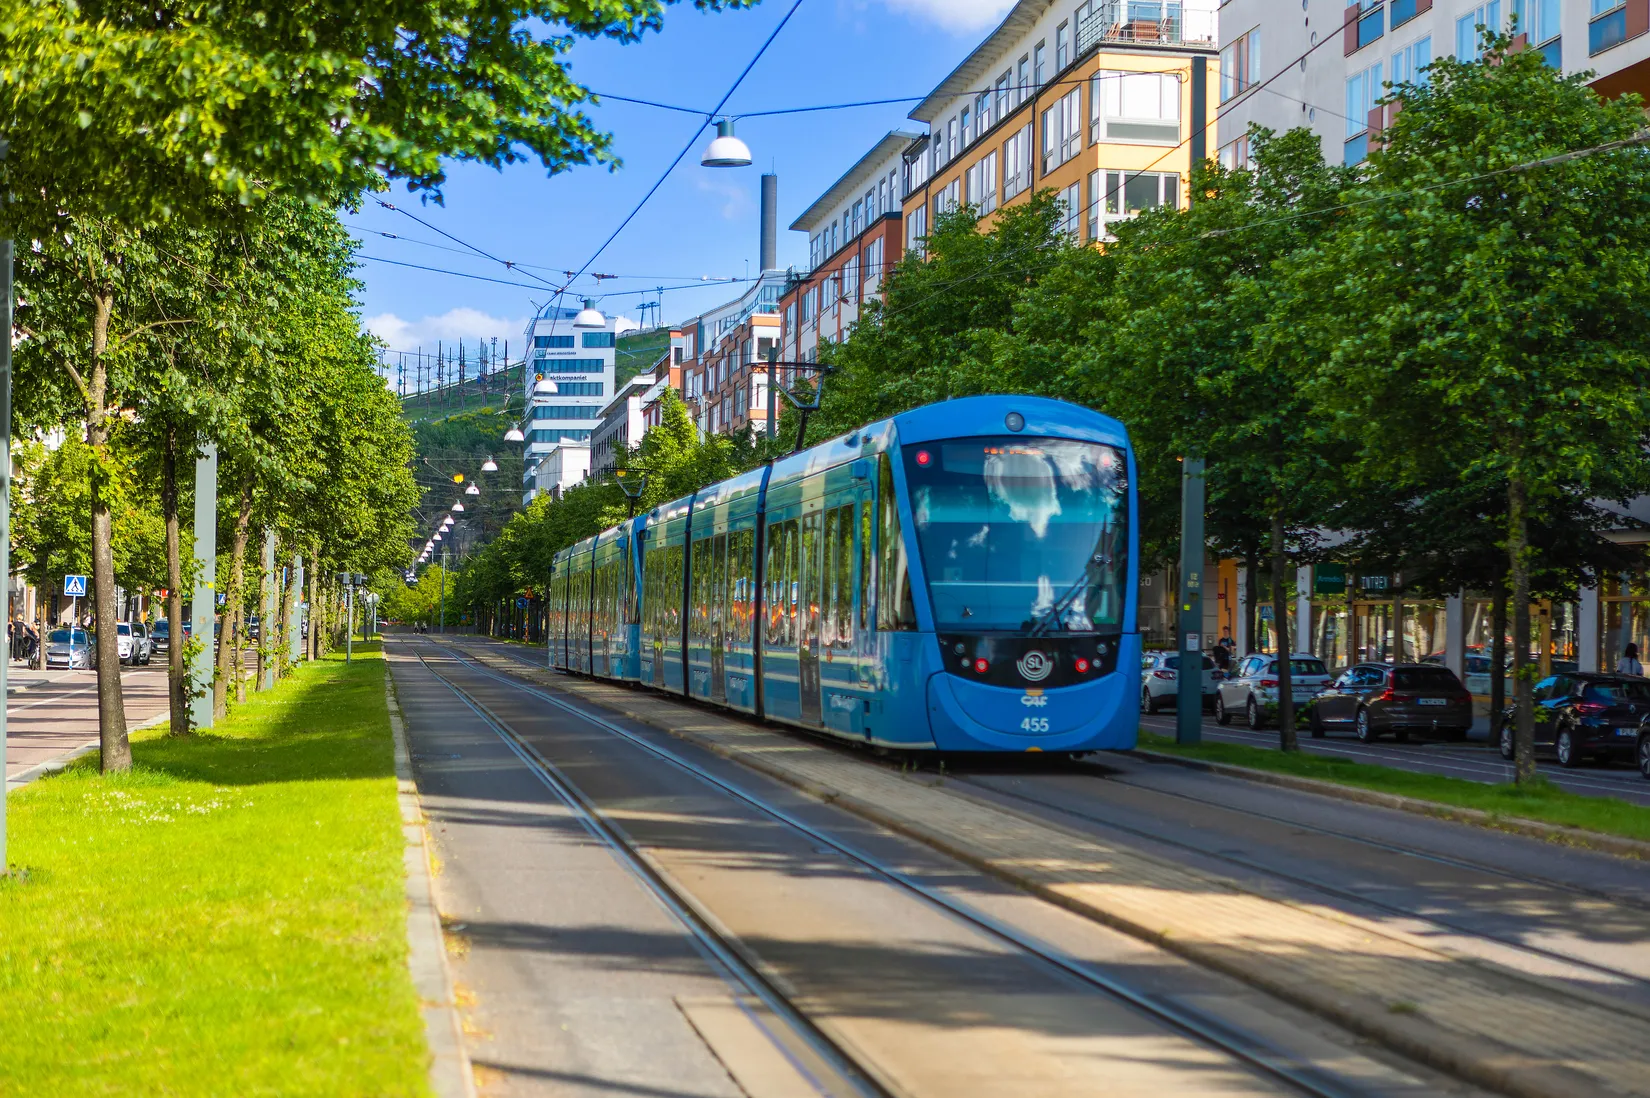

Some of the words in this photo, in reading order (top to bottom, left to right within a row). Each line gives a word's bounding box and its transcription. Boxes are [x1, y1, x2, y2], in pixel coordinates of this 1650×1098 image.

[549, 374, 588, 382] aktkompaniet
[1027, 657, 1042, 669] SL
[1020, 717, 1050, 732] 455
